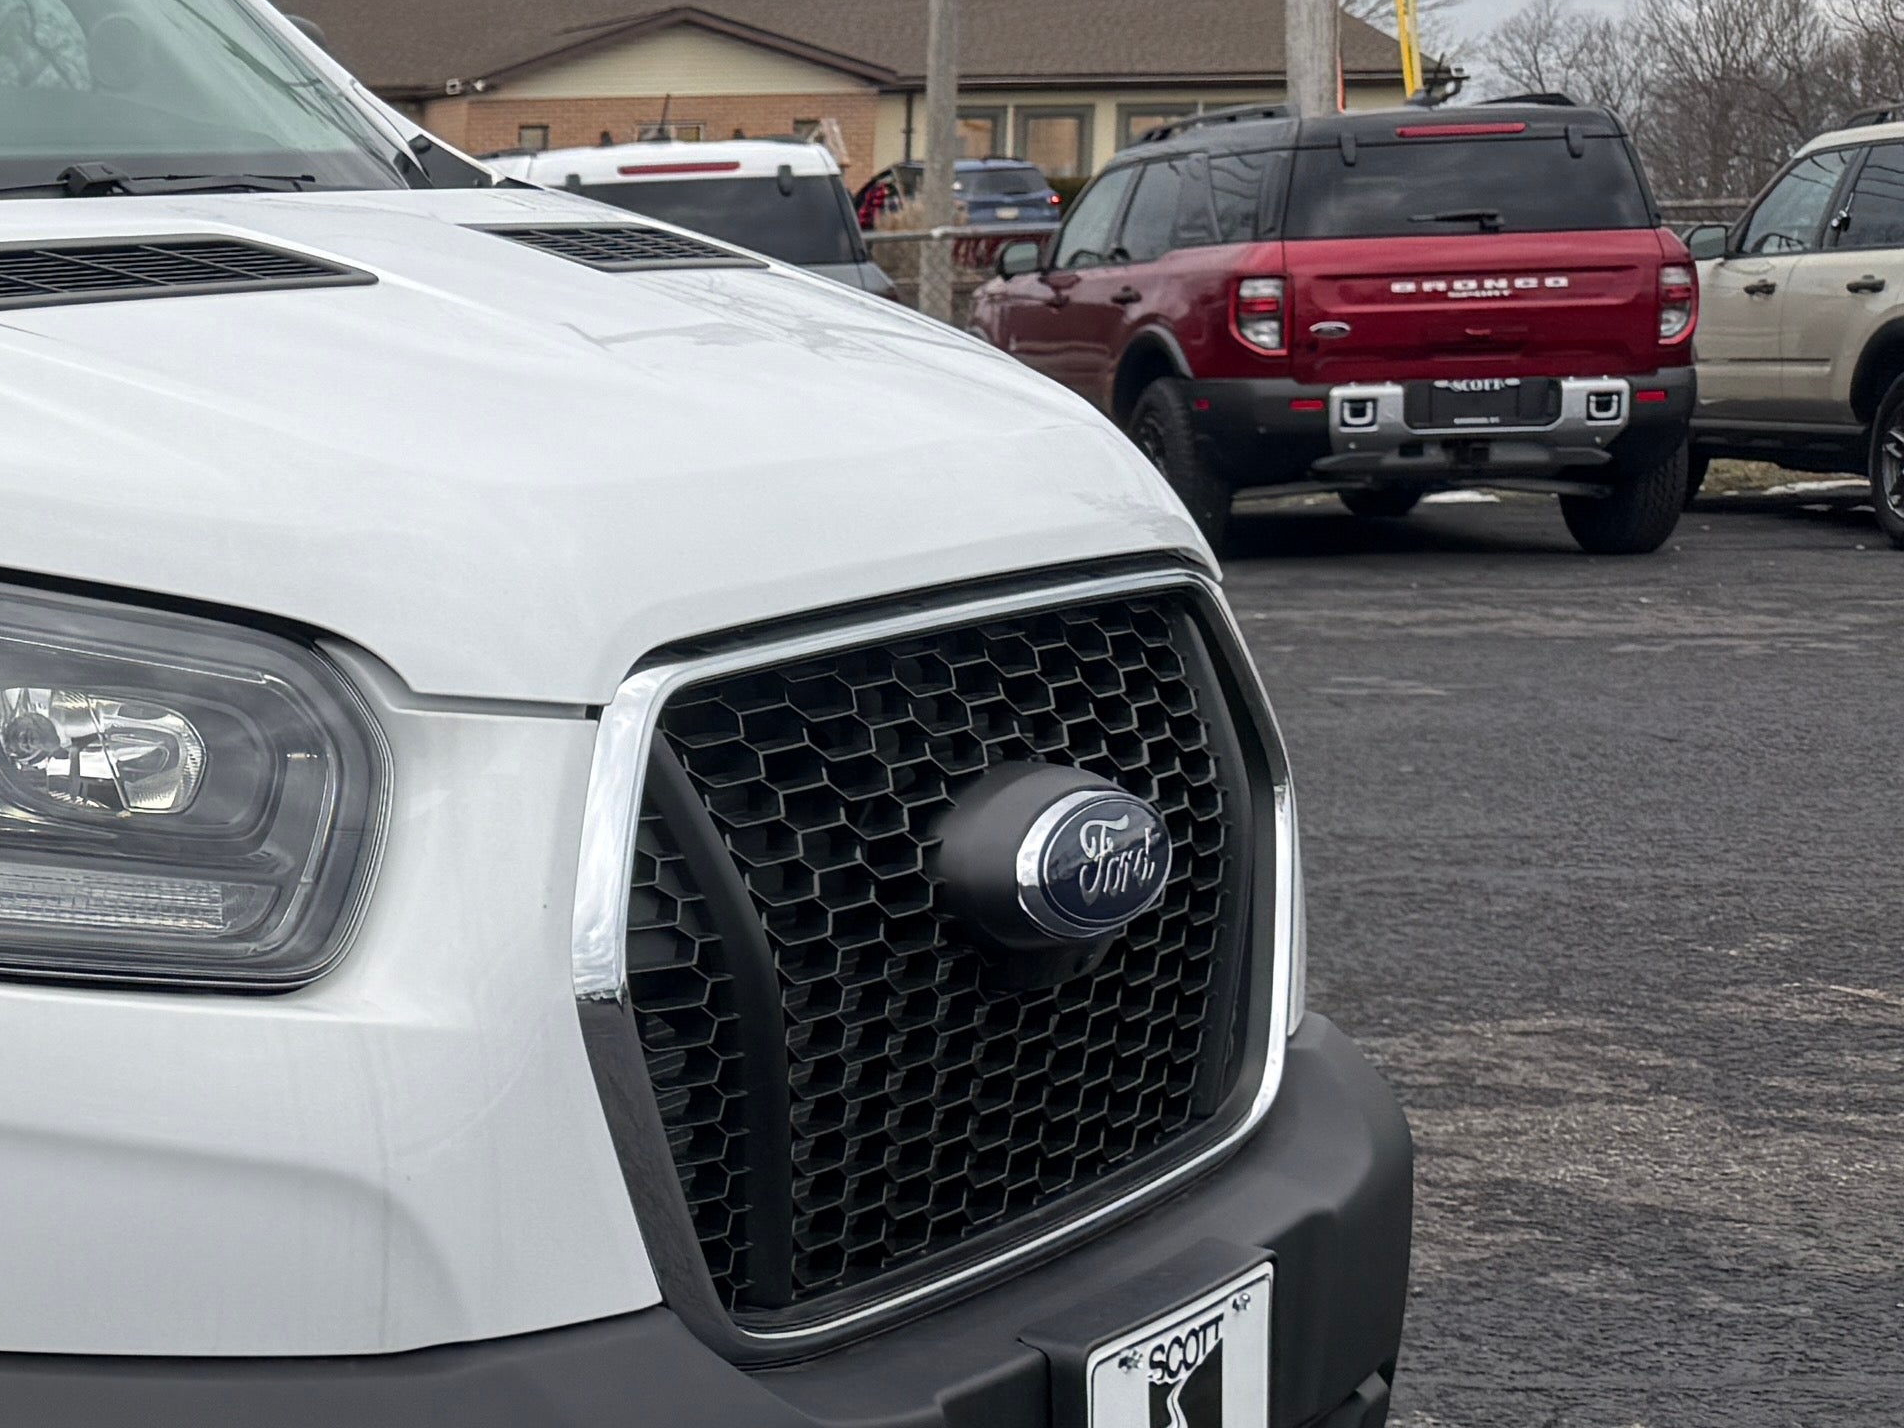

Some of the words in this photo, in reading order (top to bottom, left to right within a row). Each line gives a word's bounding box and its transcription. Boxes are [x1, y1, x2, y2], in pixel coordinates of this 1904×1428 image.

[1390, 276, 1569, 294] BRONCO
[1079, 814, 1159, 906] Ford
[1147, 1312, 1224, 1381] SCOTT
